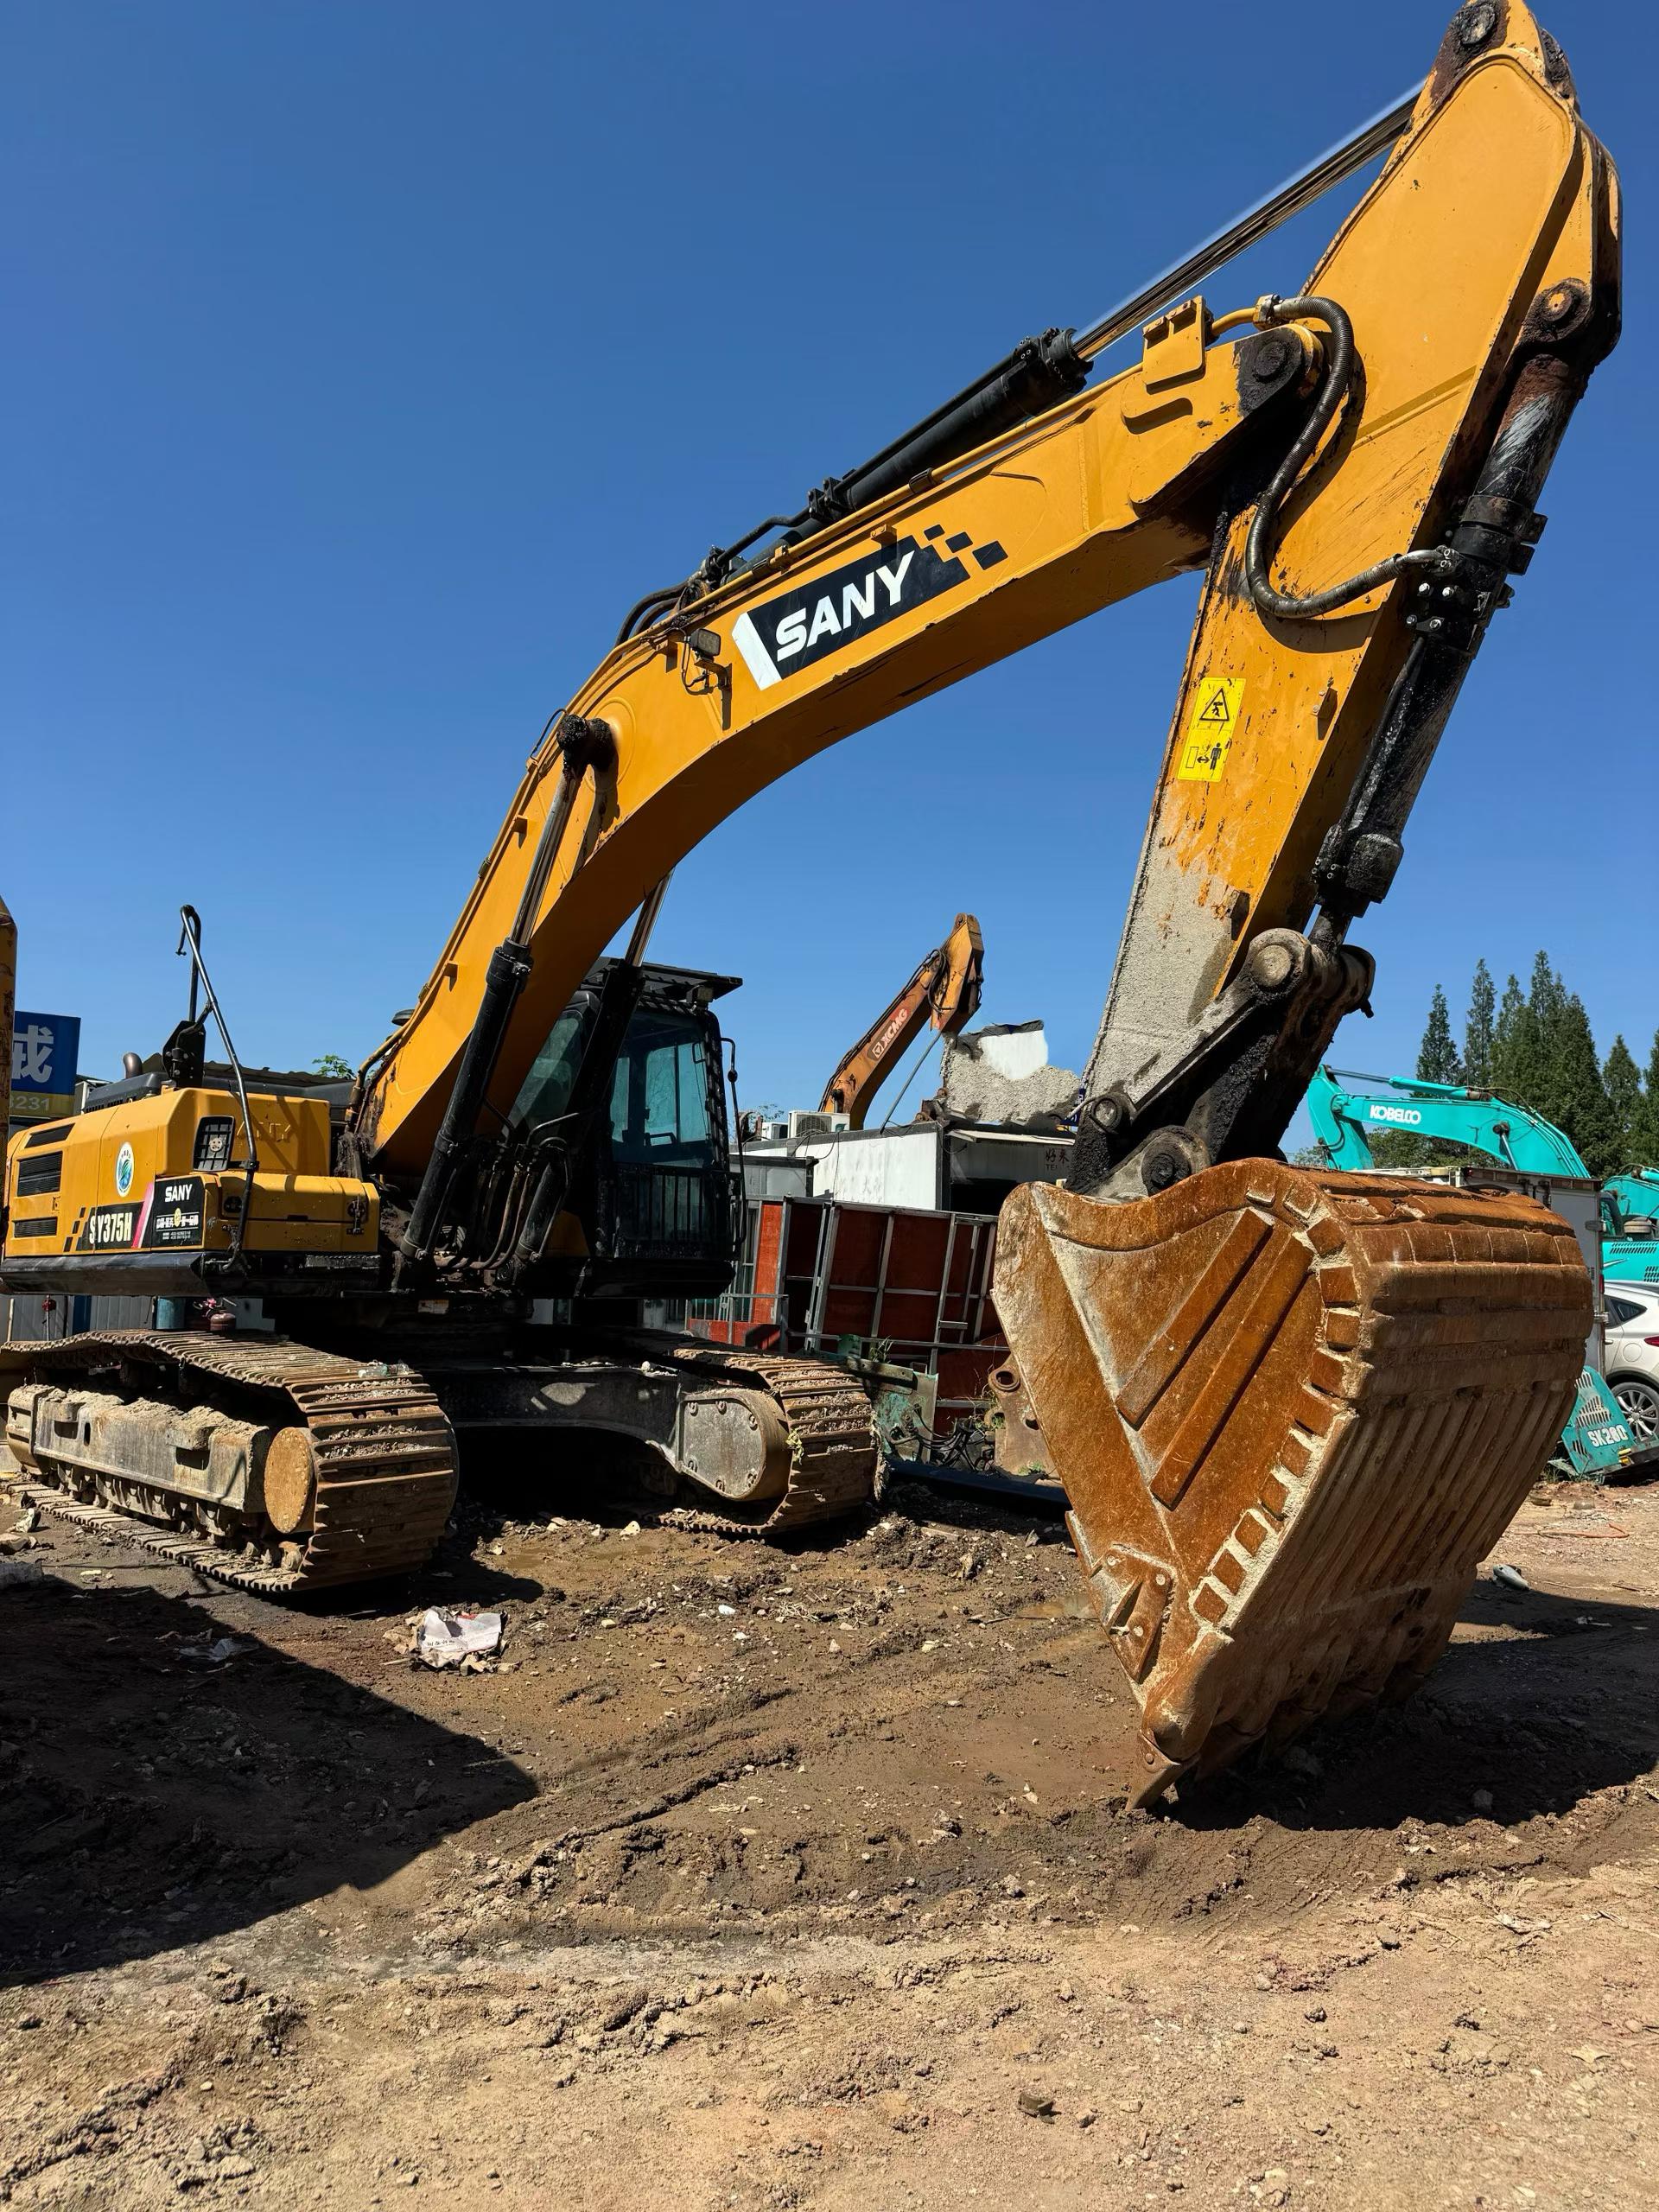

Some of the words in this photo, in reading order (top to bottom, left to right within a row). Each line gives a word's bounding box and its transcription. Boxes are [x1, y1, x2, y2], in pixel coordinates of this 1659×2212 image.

[776, 550, 915, 662] SANY
[880, 1008, 908, 1048] XCMG
[10, 1096, 49, 1111] 231
[1370, 1104, 1422, 1125] KOBELCO
[164, 1184, 193, 1203] SANY
[89, 1211, 132, 1244] SY375H
